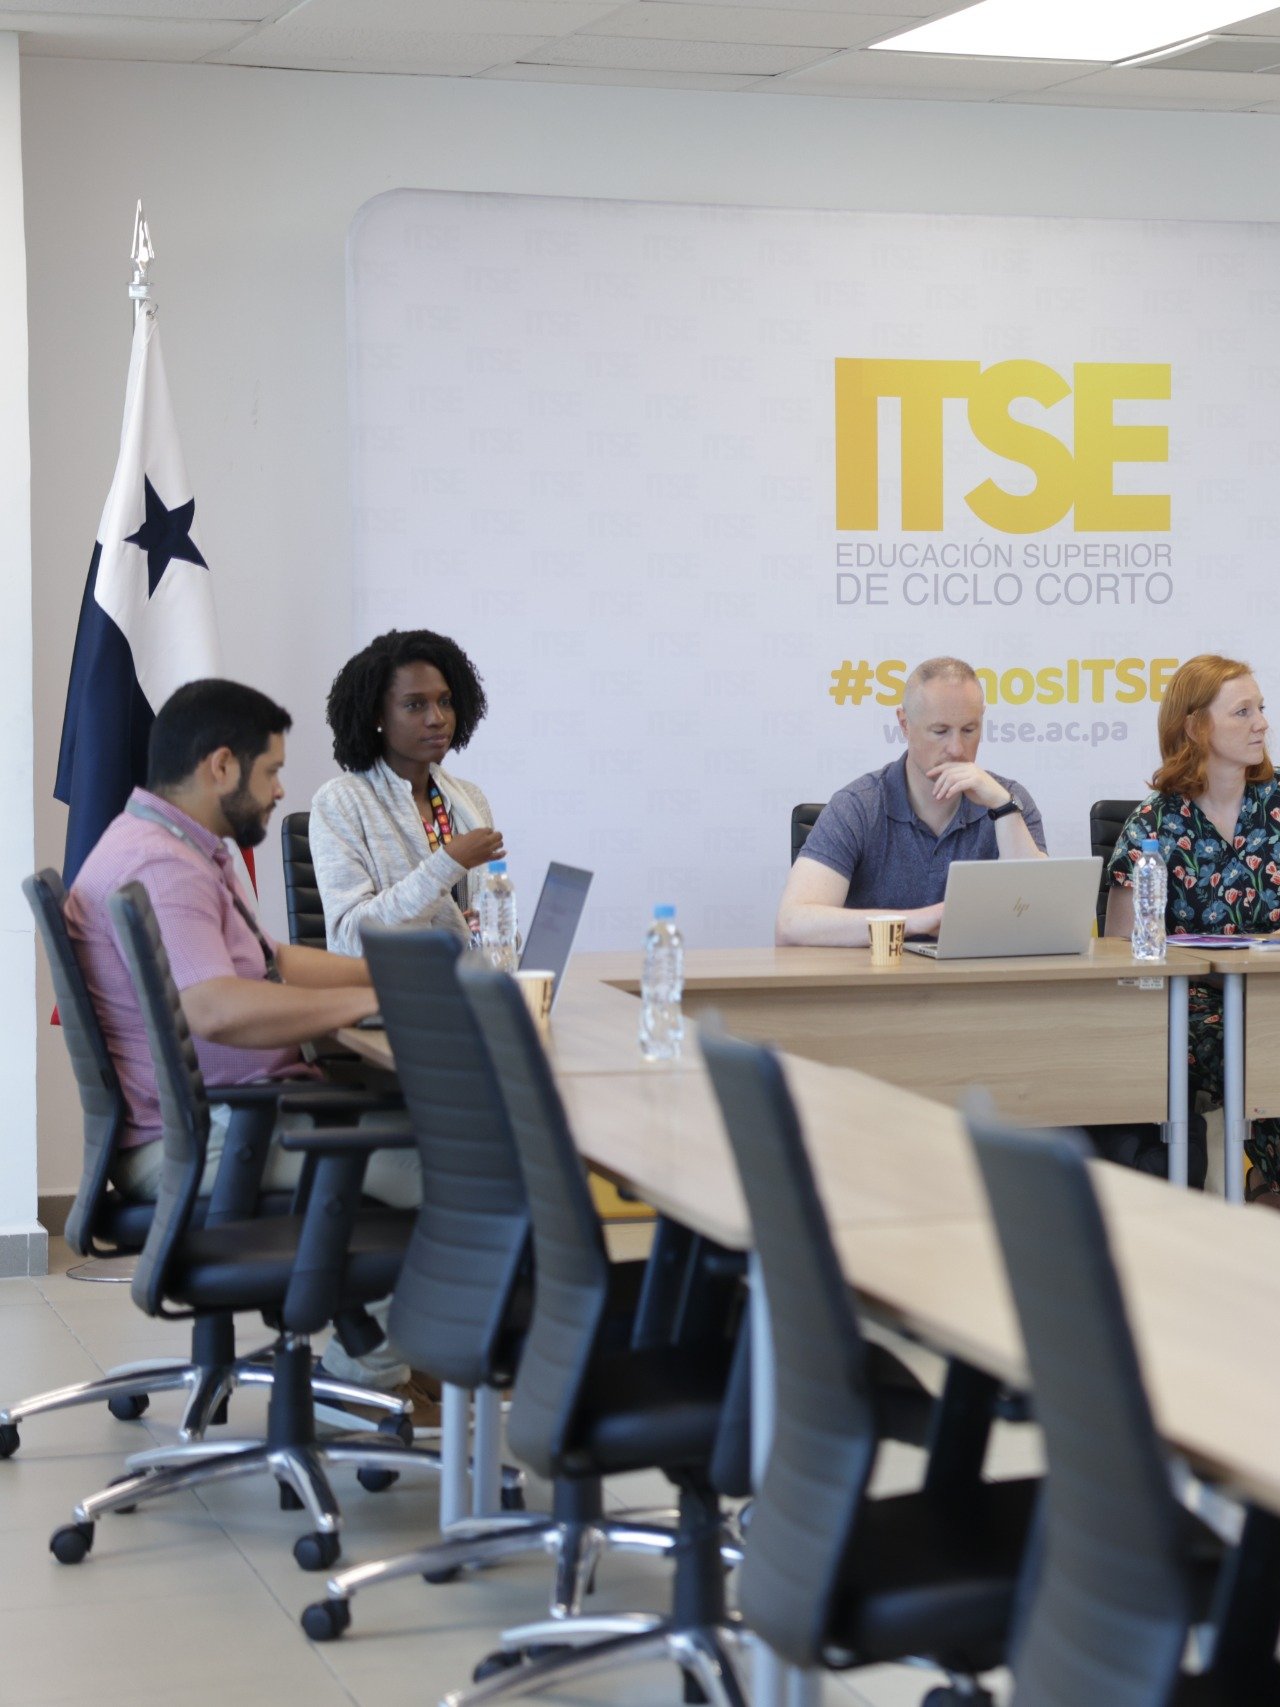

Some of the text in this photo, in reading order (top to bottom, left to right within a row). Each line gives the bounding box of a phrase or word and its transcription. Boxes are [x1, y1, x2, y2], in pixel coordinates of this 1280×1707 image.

[835, 357, 1171, 535] ITSE
[836, 538, 1172, 569] EDUCACIÓN SUPERIOR
[837, 572, 1174, 606] DE CICLO CORTO
